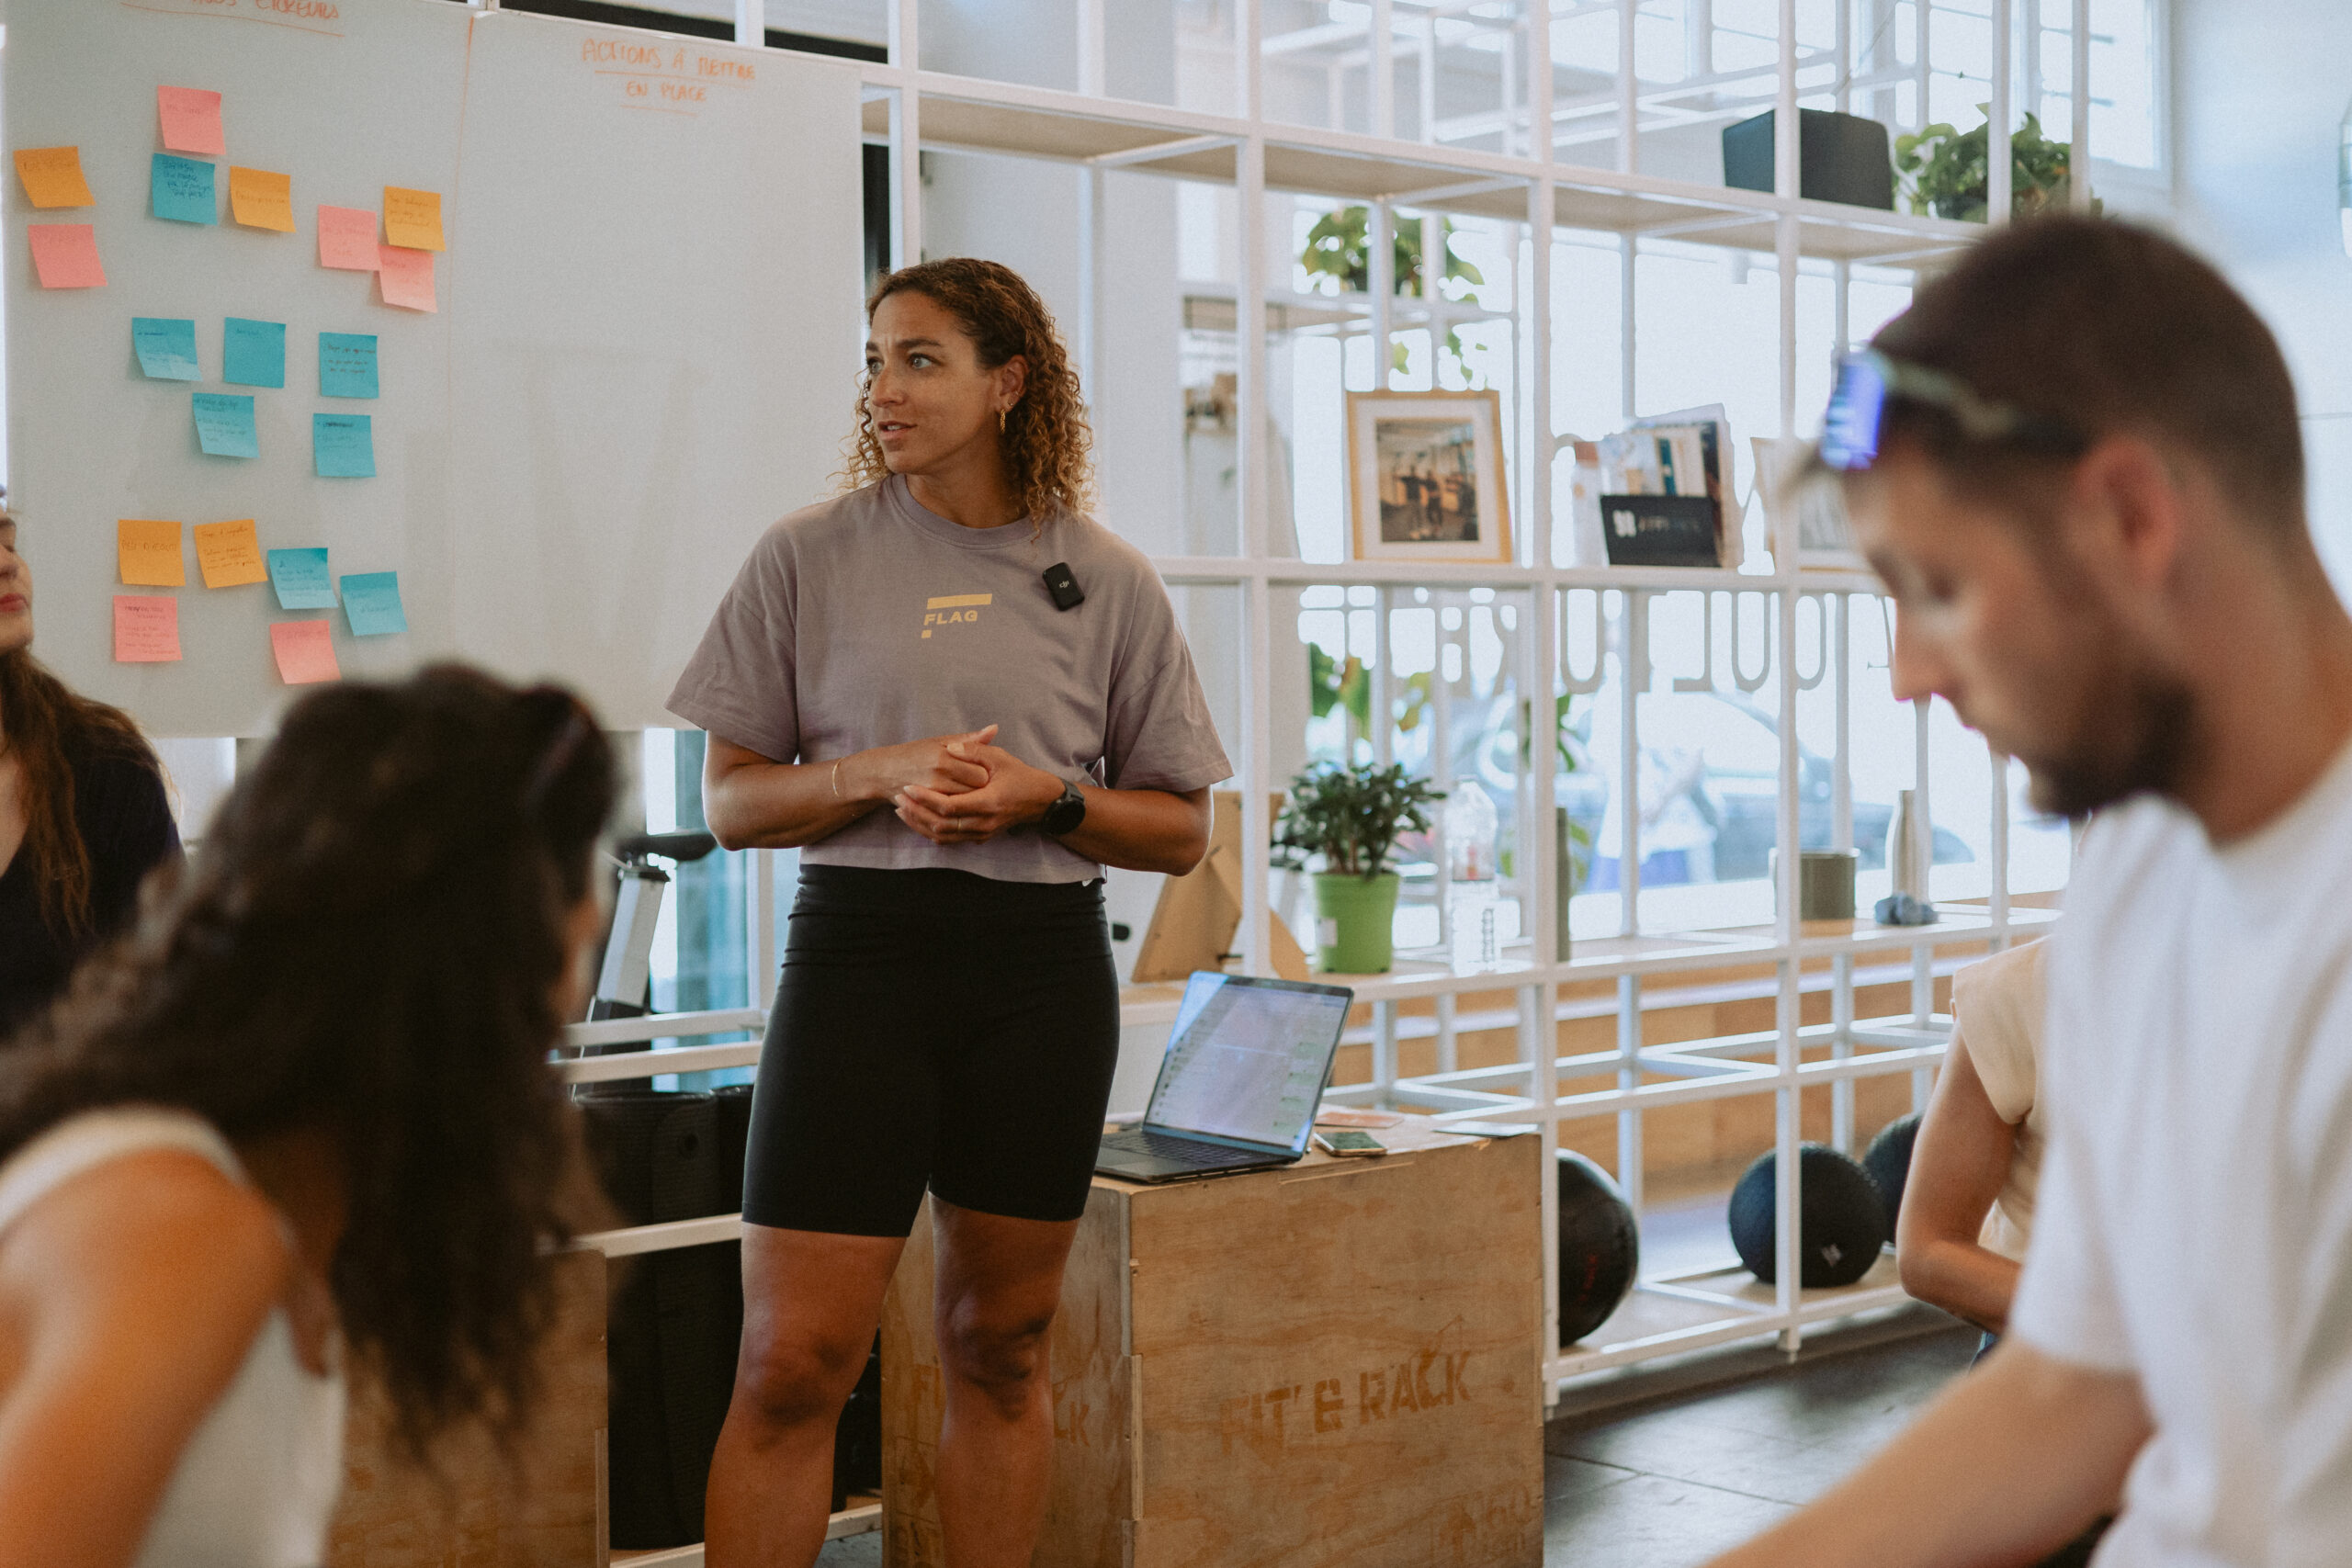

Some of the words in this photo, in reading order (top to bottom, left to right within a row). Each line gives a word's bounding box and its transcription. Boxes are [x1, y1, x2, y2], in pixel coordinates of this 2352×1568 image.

[582, 38, 662, 69] ACTIONS
[626, 80, 648, 97] EN
[661, 81, 707, 102] PLACE
[923, 609, 978, 626] FLAG
[1360, 1347, 1472, 1425] RACK
